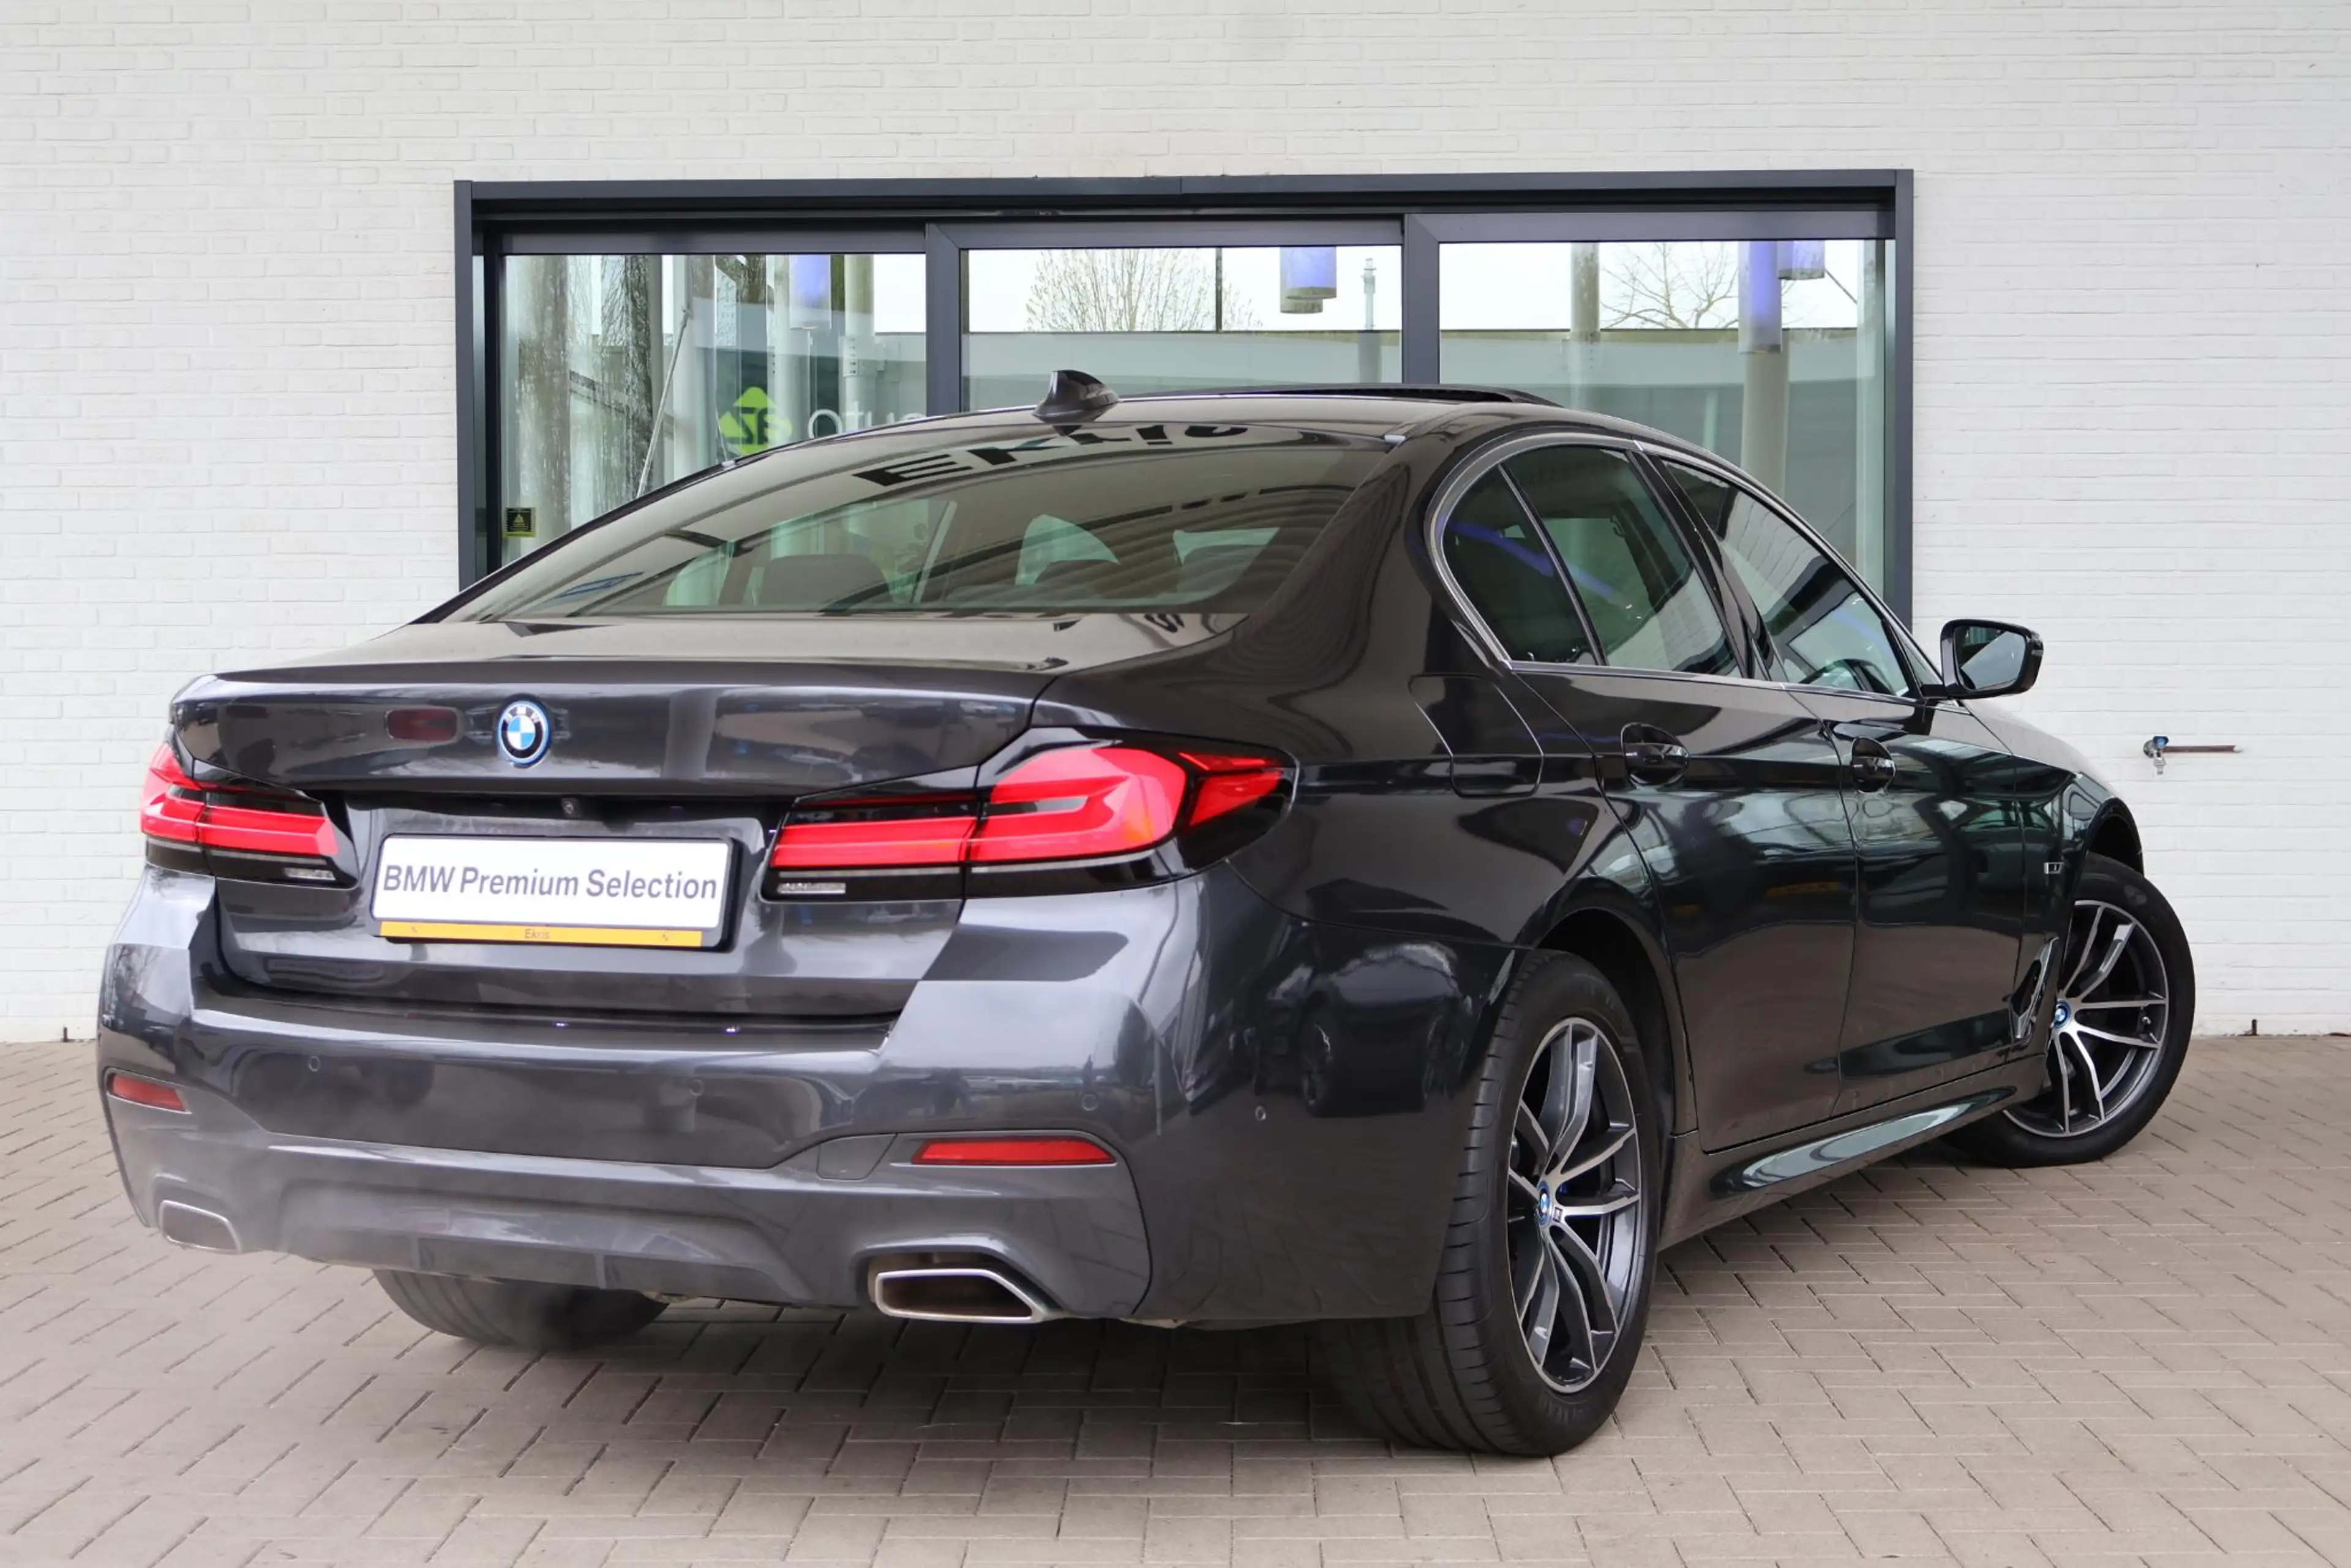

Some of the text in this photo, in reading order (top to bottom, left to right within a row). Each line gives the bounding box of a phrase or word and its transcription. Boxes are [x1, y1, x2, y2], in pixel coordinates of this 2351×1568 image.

[383, 865, 717, 899] BMW Premium Selection
